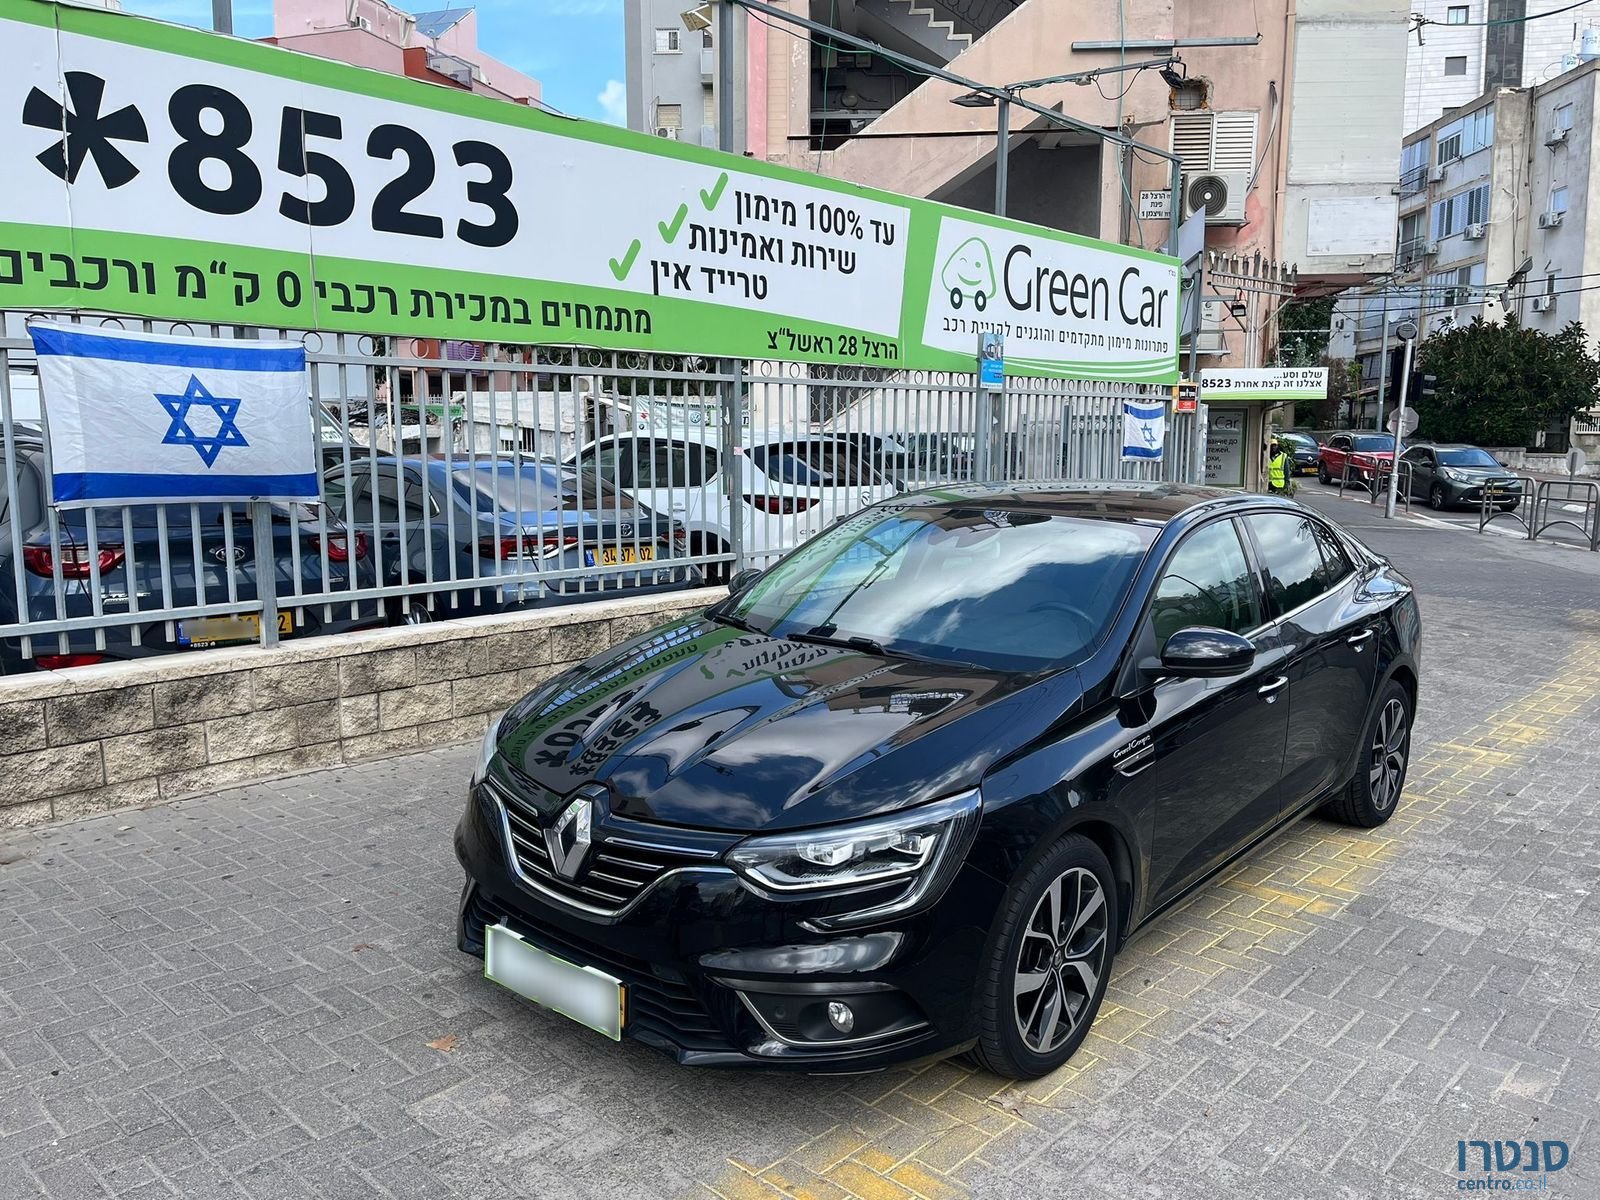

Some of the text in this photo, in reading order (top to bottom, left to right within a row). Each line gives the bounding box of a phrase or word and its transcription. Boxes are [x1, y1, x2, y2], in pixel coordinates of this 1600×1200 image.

[734, 190, 895, 246] עד 100% מימון
[688, 223, 856, 275] שירות ואמינות
[650, 260, 768, 300] טרייד אין
[1003, 244, 1169, 329] Green Car
[276, 270, 302, 308] 0
[315, 280, 399, 316] רכבי
[410, 288, 532, 326] במכירת
[541, 299, 652, 335] מתמחים
[942, 316, 967, 333] רכב
[1016, 326, 1055, 343] והוגנים
[1059, 331, 1105, 349] מתקדמים
[1107, 334, 1132, 351] מימון
[767, 327, 898, 360] הרצל 28 ראשל"צ
[1134, 338, 1169, 354] פתרונות
[1296, 379, 1322, 388] אצלנו
[1301, 371, 1323, 379] שלם
[1234, 380, 1259, 388] אחרת
[1261, 380, 1281, 389] קצת
[1283, 380, 1293, 388] זה
[1215, 416, 1240, 430] Car
